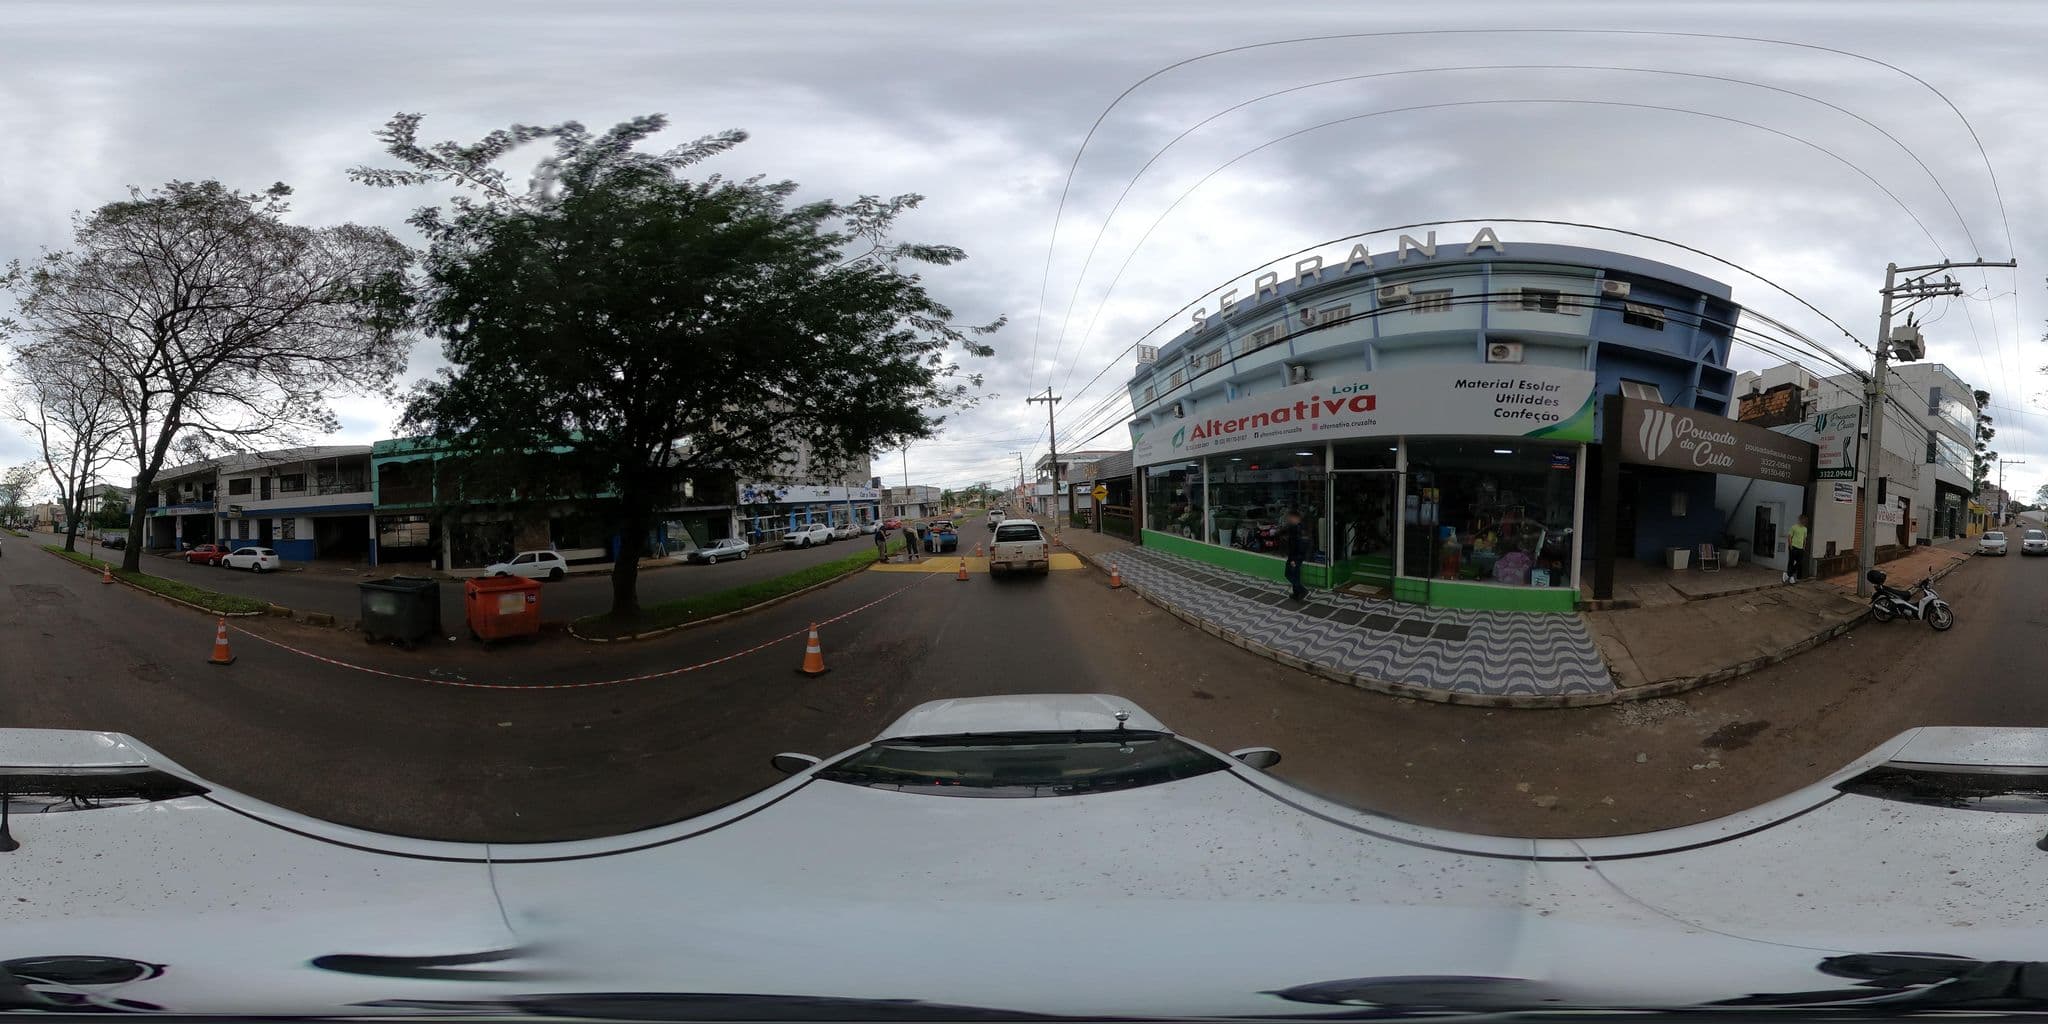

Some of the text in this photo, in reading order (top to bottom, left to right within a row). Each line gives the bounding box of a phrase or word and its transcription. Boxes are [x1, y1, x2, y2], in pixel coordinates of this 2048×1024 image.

[1191, 226, 1505, 337] SERRANA
[1332, 383, 1369, 394] Loja
[1455, 379, 1560, 392] Material Esolar
[1496, 393, 1559, 407] Utiliddes
[1190, 394, 1377, 442] Alternativa
[1494, 408, 1559, 423] Confeção
[1675, 417, 1736, 446] Pousada
[1680, 438, 1735, 467] da Cuia
